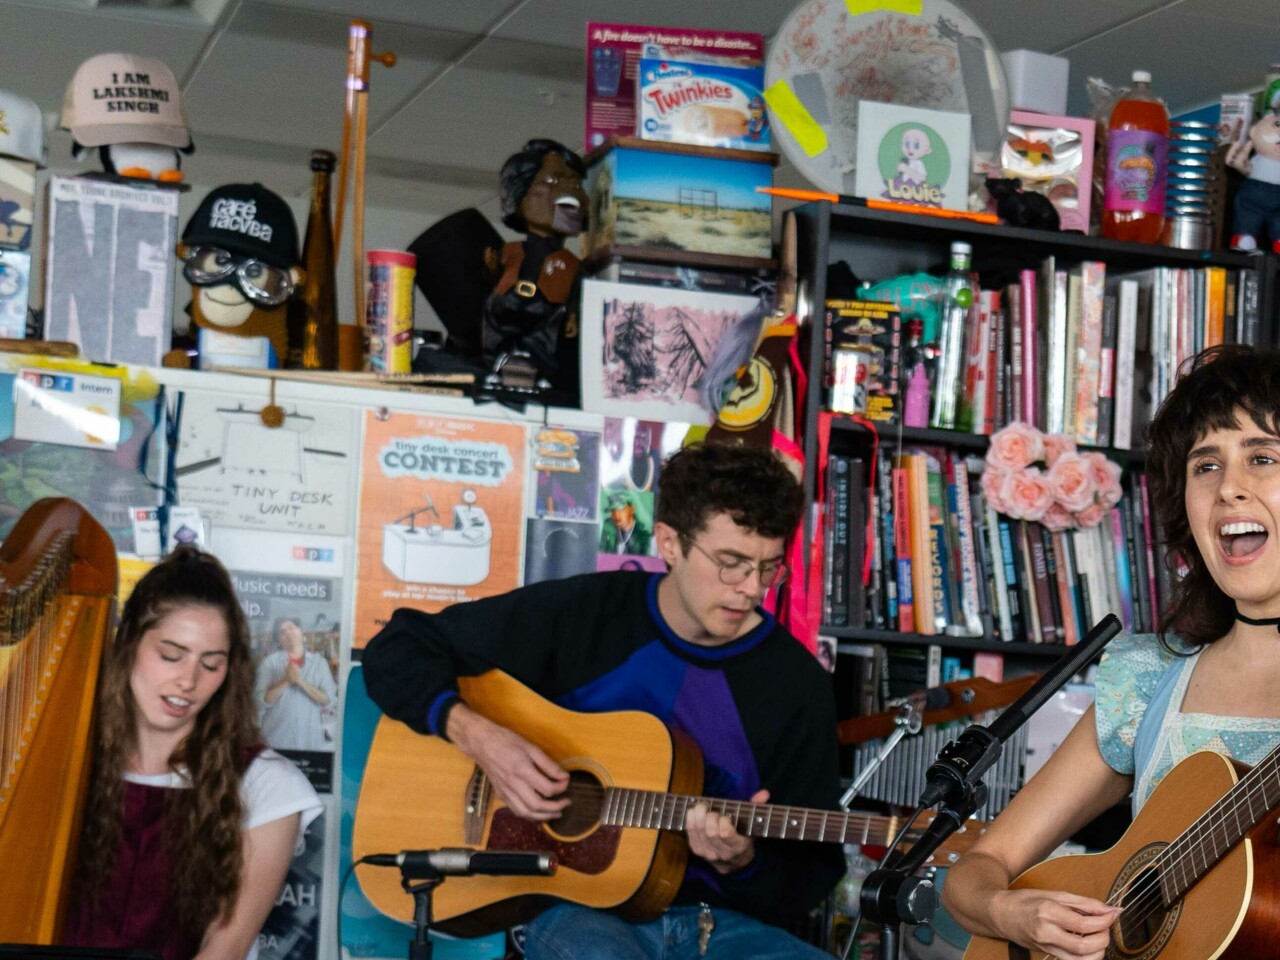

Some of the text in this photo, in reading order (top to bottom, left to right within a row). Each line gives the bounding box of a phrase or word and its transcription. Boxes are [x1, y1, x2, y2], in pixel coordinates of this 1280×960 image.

[594, 30, 603, 40] A
[603, 30, 619, 42] fire
[657, 33, 679, 45] have
[681, 35, 692, 46] to
[693, 36, 706, 47] be
[707, 39, 714, 48] a
[112, 73, 150, 86] I AM
[93, 87, 170, 102] LAKSHMI
[648, 80, 734, 117] Twinkies
[107, 101, 160, 114] SINGH
[887, 179, 942, 204] Louie
[81, 383, 113, 395] Intern
[395, 441, 498, 459] tiny desk concert
[384, 450, 506, 479] CONTEST
[233, 485, 334, 506] TINY DESK
[258, 502, 303, 517] UNIT
[838, 479, 848, 546] INSIDE OUT
[276, 580, 327, 598] needs
